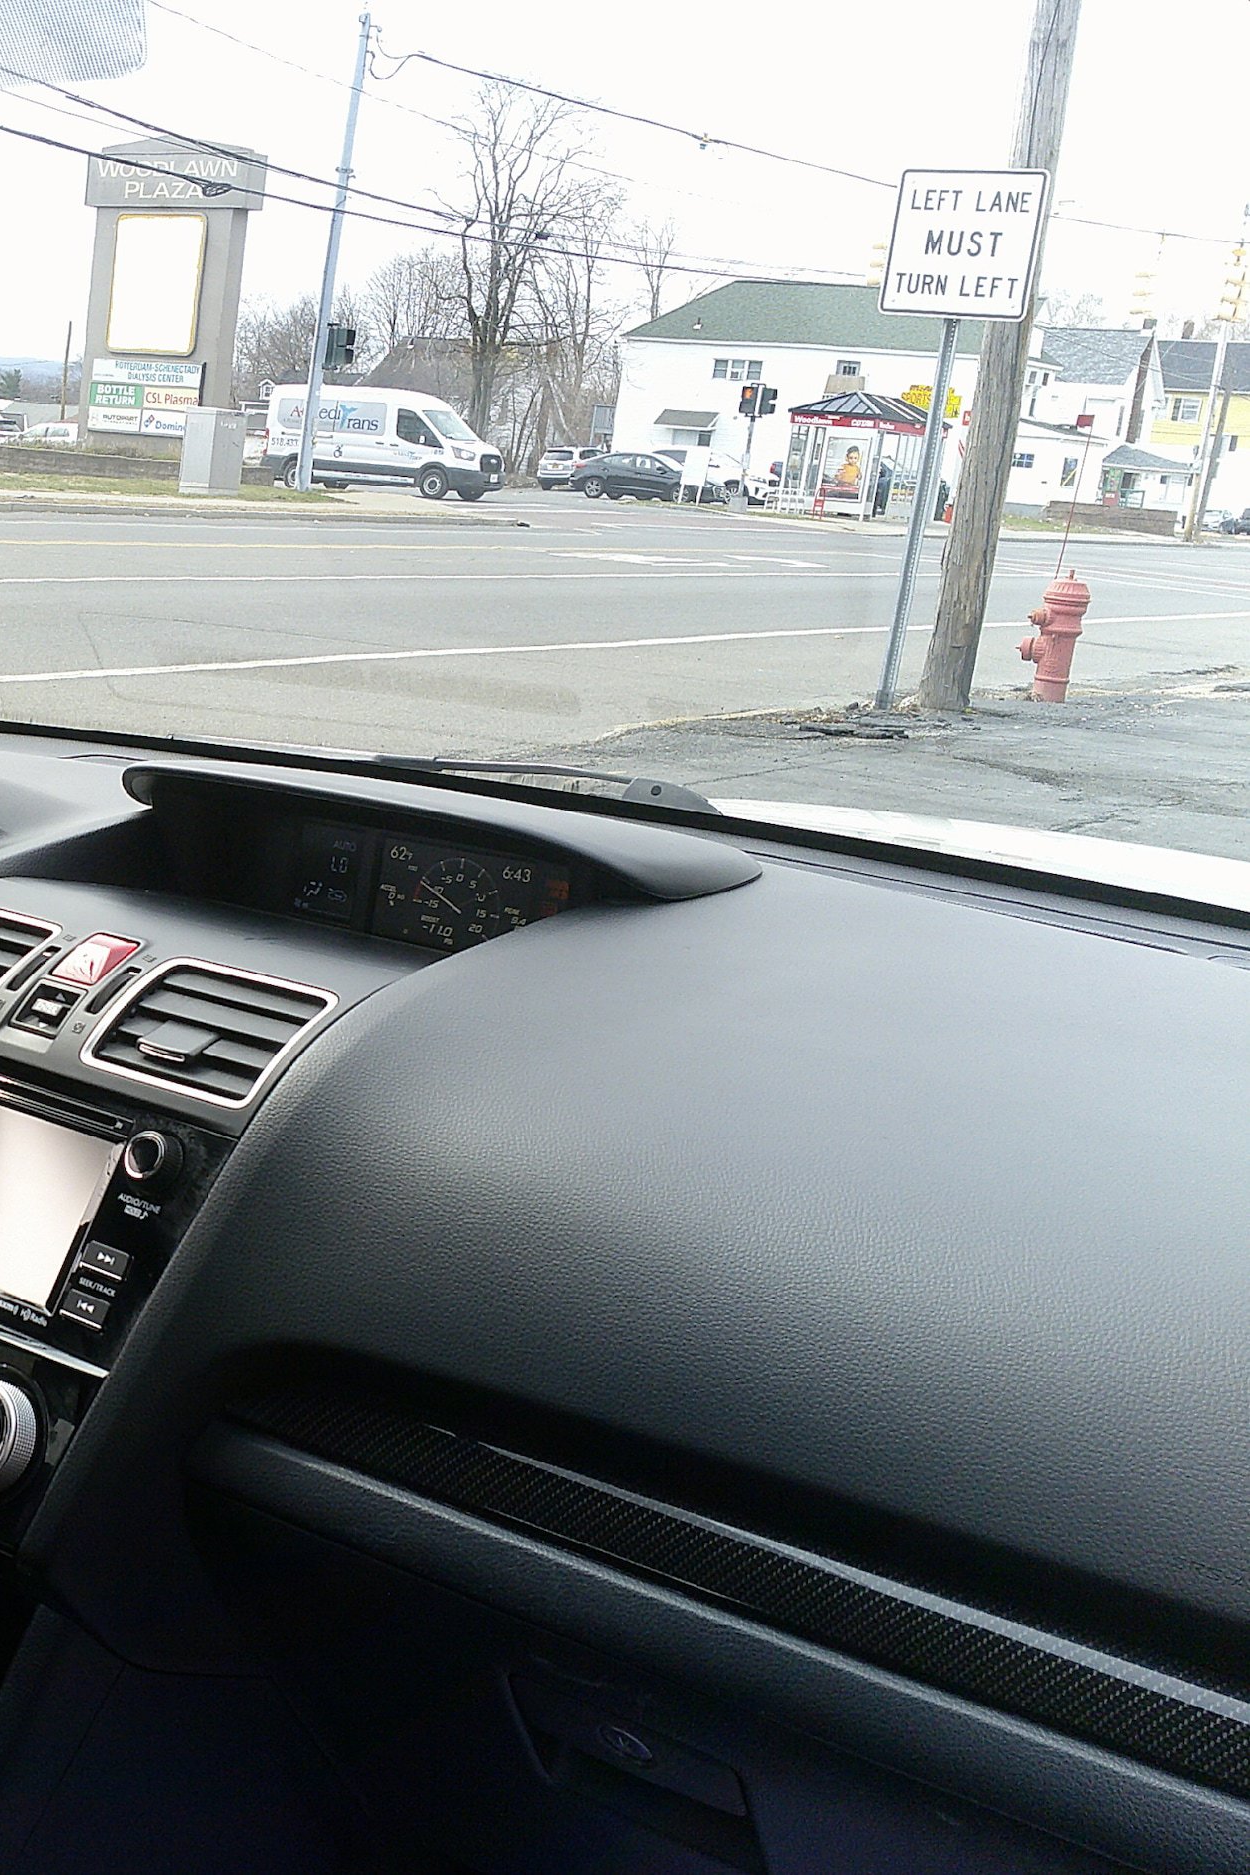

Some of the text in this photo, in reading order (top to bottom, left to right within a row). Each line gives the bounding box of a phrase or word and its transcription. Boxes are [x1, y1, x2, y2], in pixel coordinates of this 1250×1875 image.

[97, 159, 238, 178] WOODLAWN
[124, 181, 204, 199] PLAZA
[911, 189, 1032, 213] LEFT LANE
[924, 230, 1003, 257] MUST
[896, 272, 1019, 299] TURN LEFT
[127, 372, 184, 383] DIALYSIS CENTER
[97, 383, 136, 395] BOTTLE
[95, 394, 136, 405] RETURN
[145, 391, 199, 406] CSL Plasma
[502, 865, 531, 882] 6:43
[476, 909, 487, 918] 15
[468, 923, 483, 934] 20
[117, 1192, 161, 1215] AUDIO/TUNE
[78, 1277, 116, 1298] SEEK/TRACK
